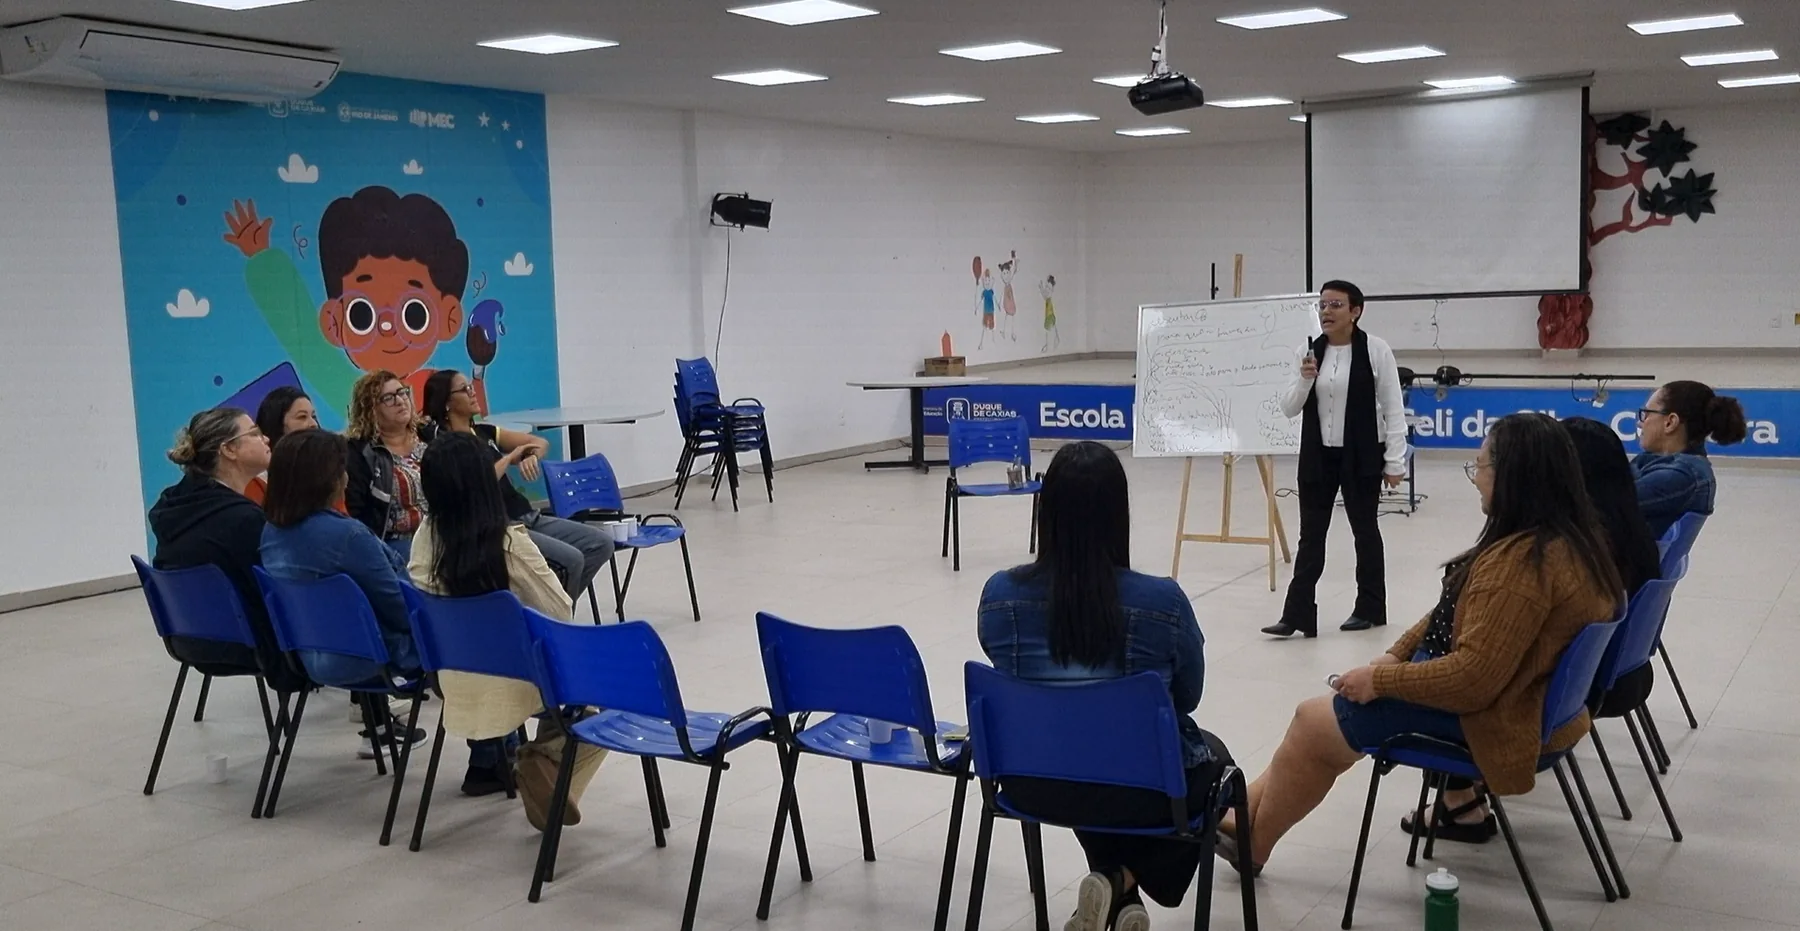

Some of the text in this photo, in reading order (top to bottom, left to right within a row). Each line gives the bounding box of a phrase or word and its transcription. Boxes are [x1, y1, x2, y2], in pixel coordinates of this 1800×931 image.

[428, 111, 455, 129] MEC
[973, 403, 1002, 411] DUQUE
[985, 410, 1017, 418] CAXIAS
[1040, 402, 1126, 429] Escola
